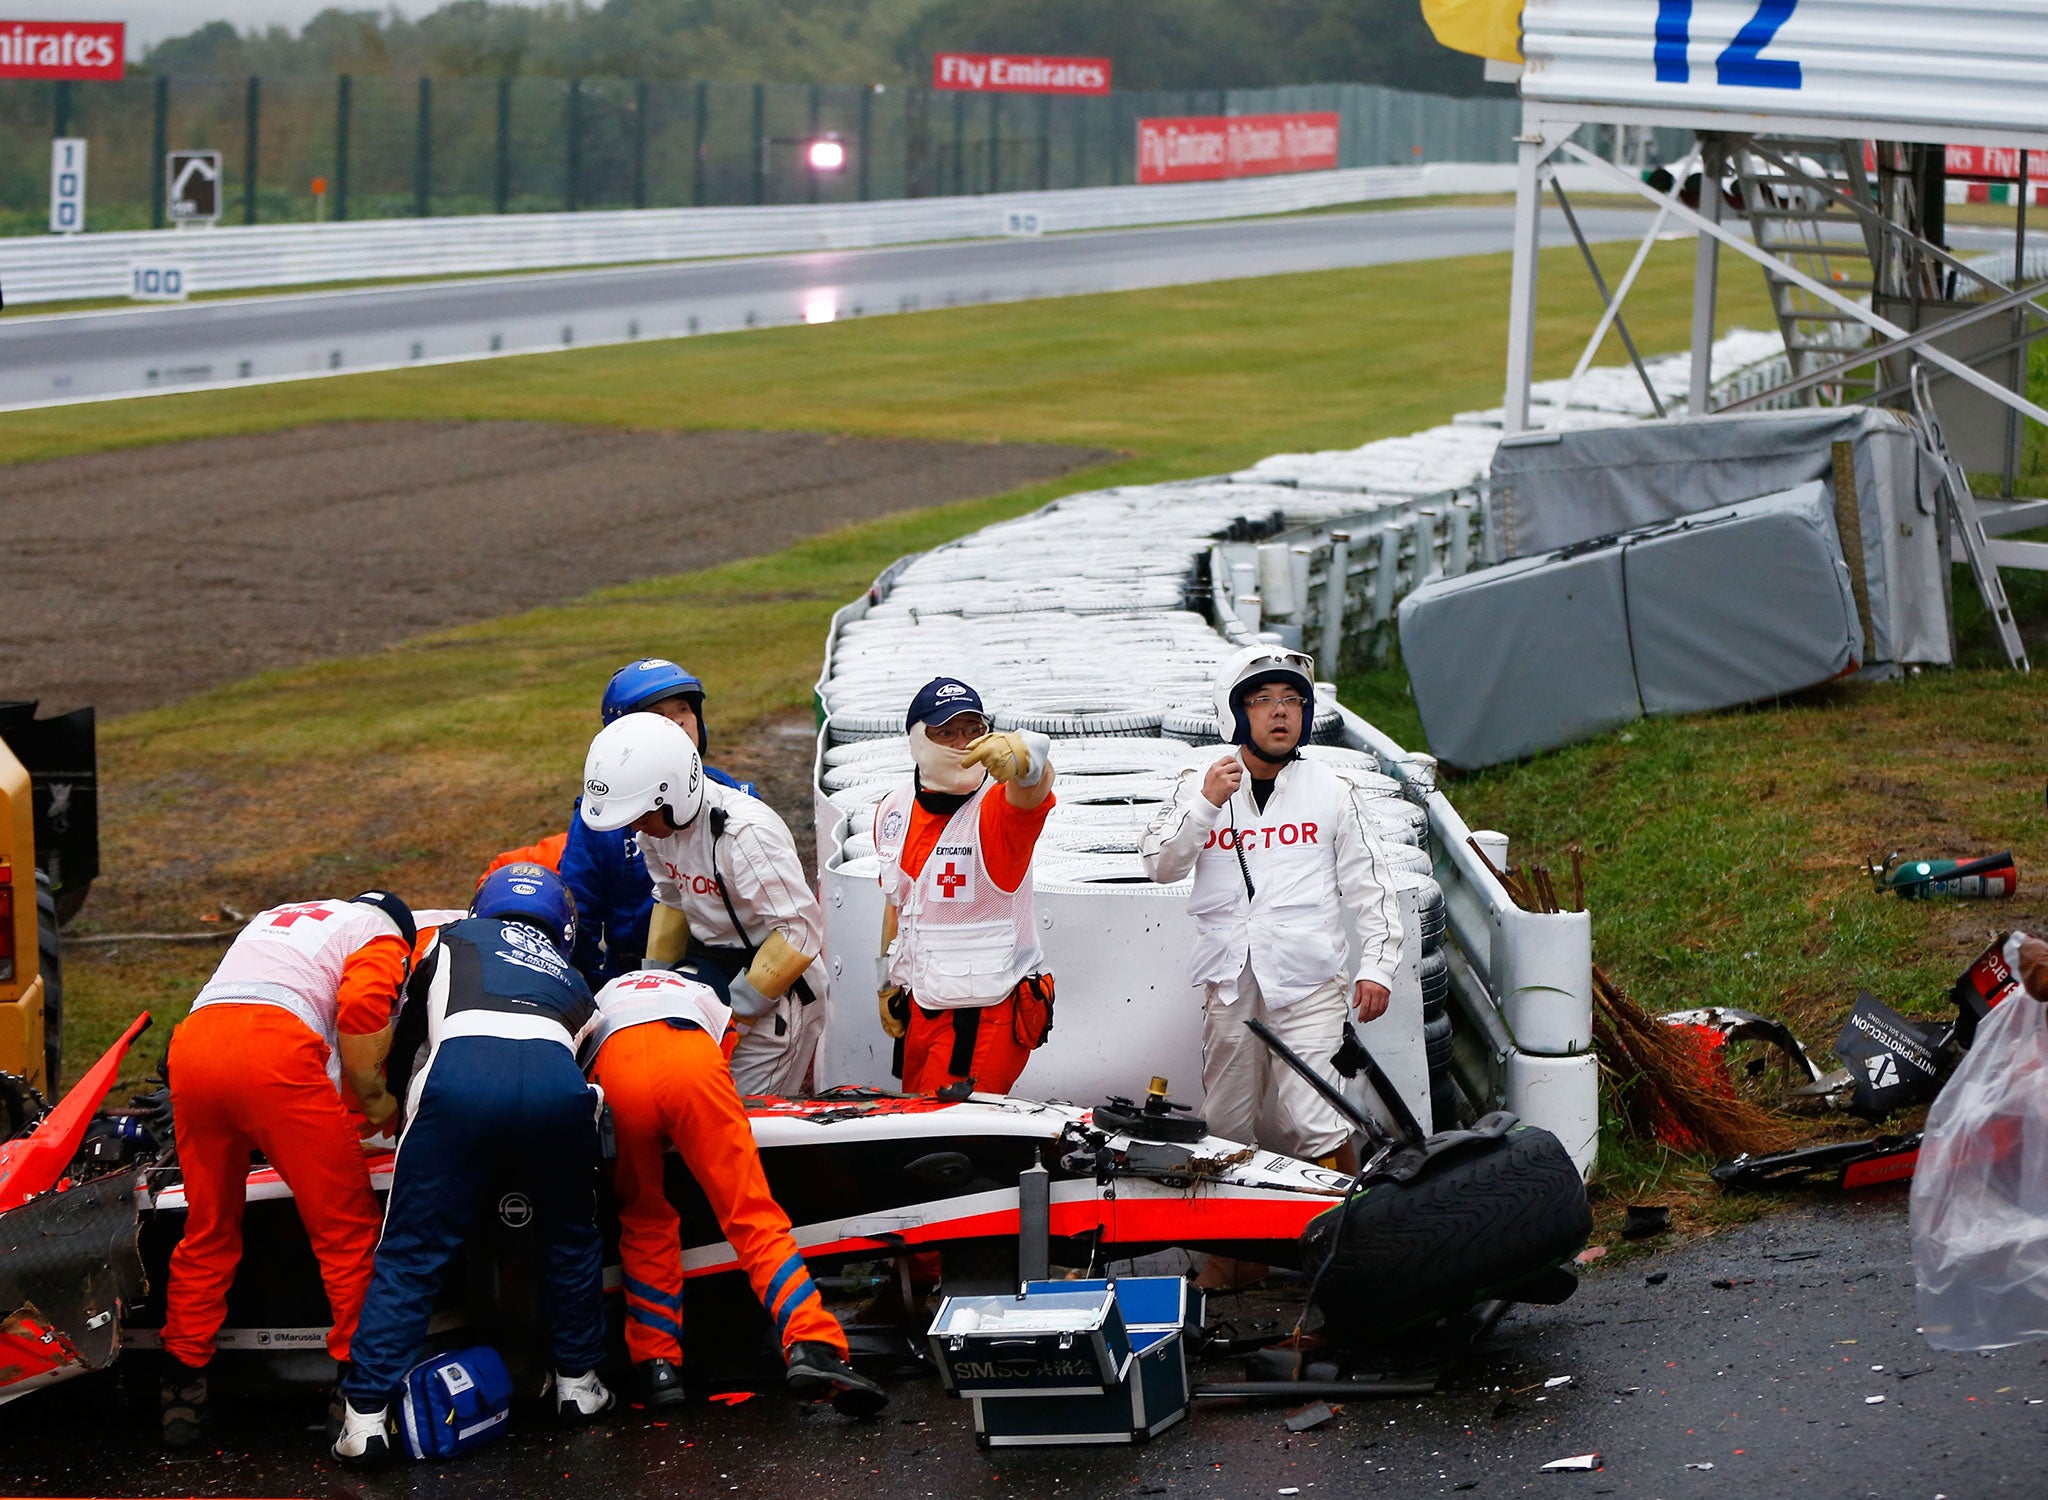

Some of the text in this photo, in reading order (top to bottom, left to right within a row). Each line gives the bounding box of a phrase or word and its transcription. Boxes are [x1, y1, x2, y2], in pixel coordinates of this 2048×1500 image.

[941, 57, 1104, 88] Fly Emirates
[1142, 126, 1167, 174] Fly
[57, 145, 78, 226] 100
[133, 269, 182, 294] 100
[941, 875, 958, 884] JRC
[1867, 1012, 1899, 1038] SOLUTIONS
